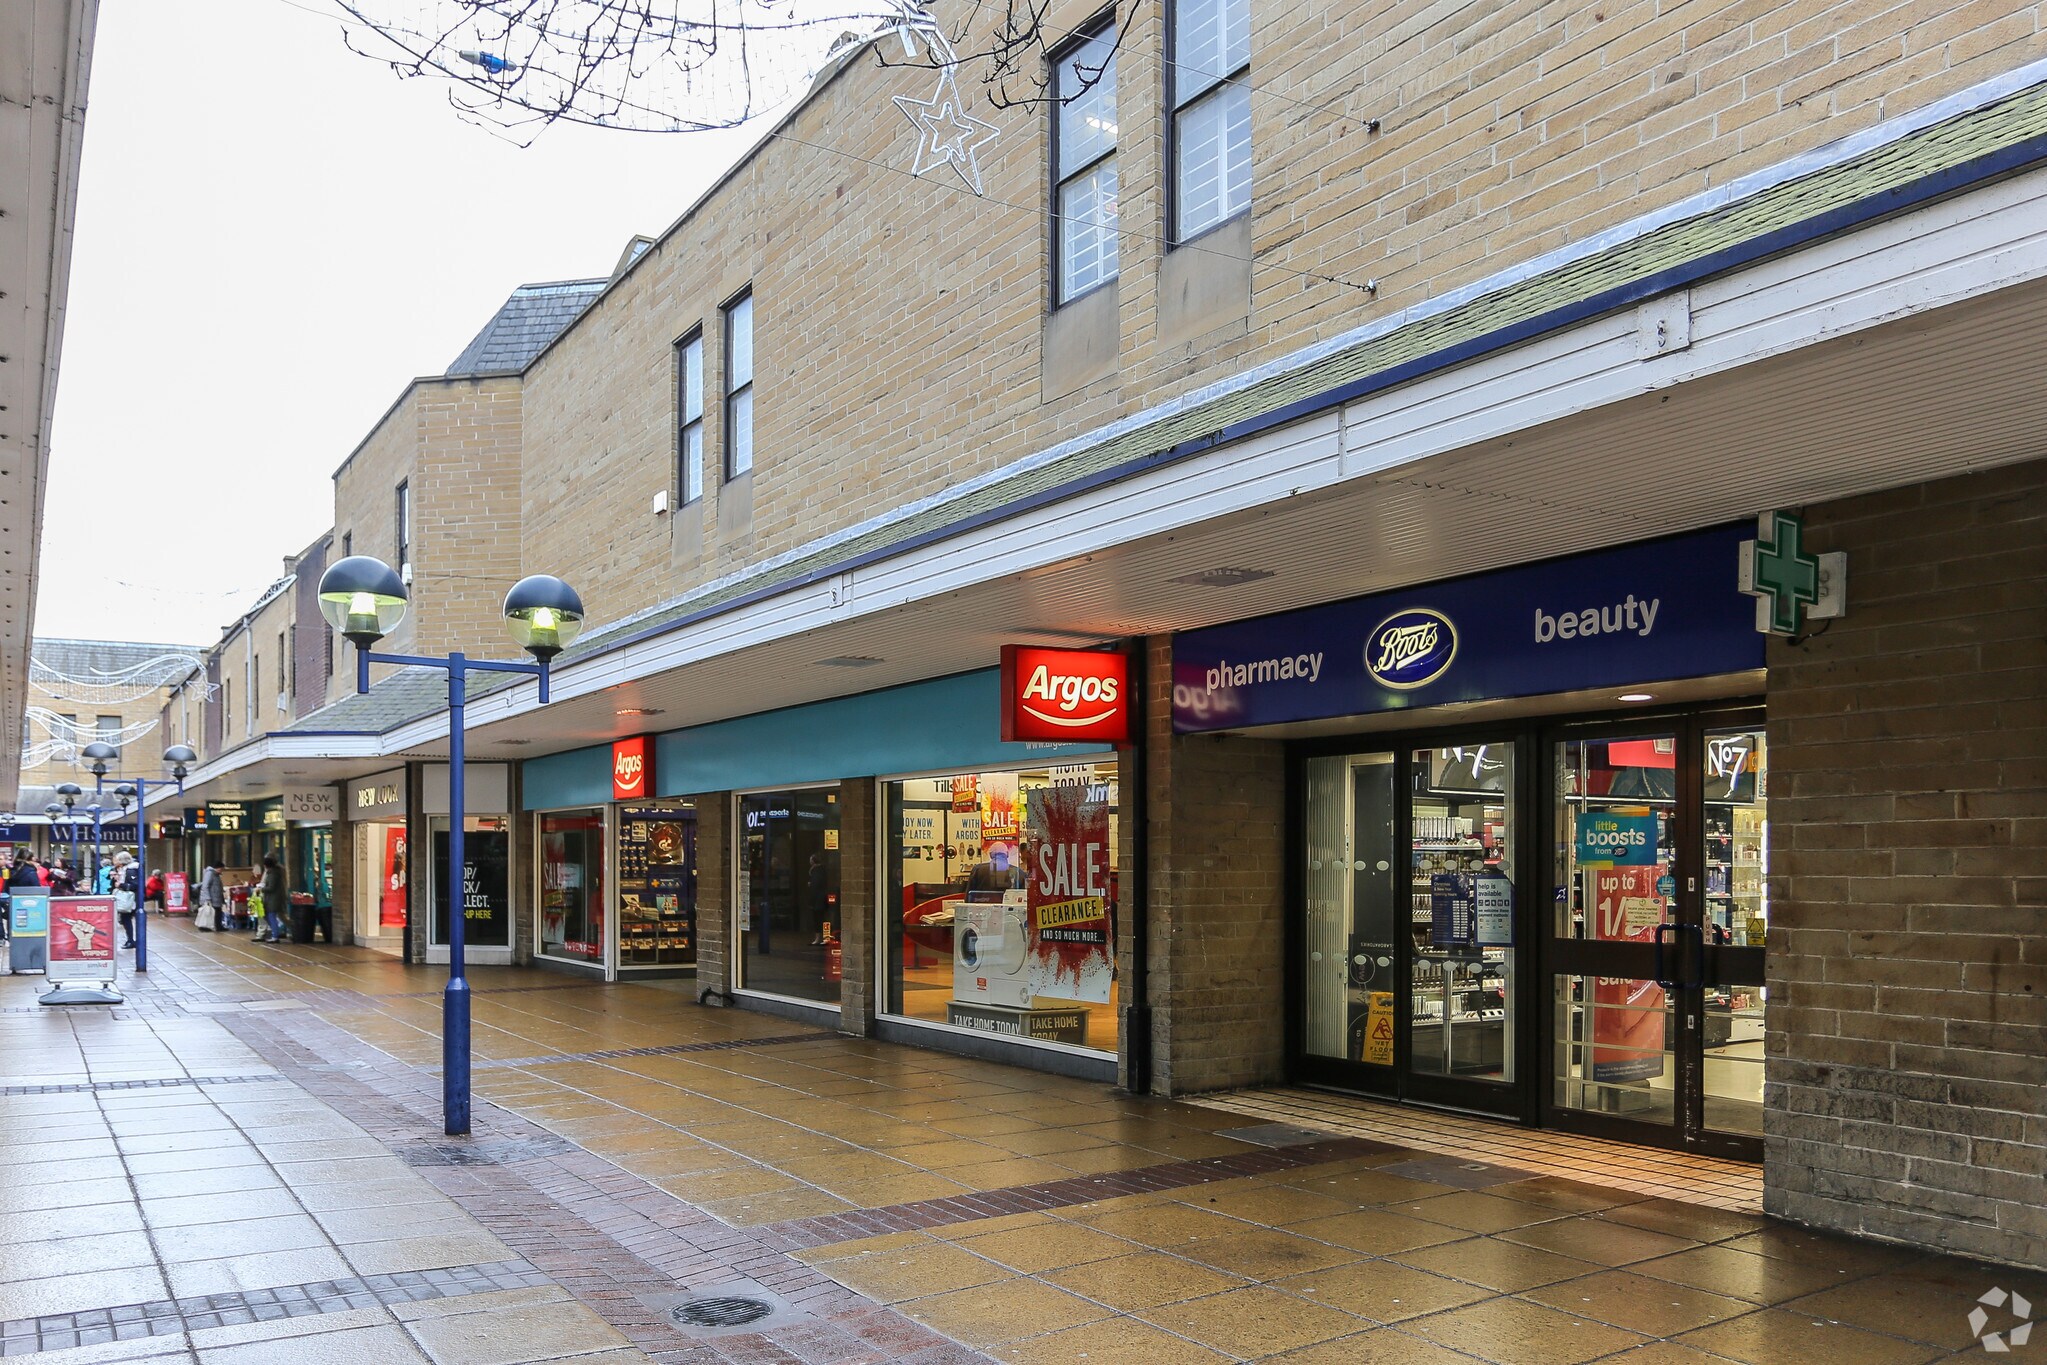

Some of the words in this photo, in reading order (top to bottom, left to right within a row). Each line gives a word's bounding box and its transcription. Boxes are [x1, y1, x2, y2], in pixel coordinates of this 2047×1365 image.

[1534, 594, 1660, 644] beauty
[1373, 621, 1439, 672] Boots
[1206, 652, 1323, 696] pharmacy
[1022, 665, 1118, 711] Argos
[615, 752, 643, 780] Argos
[1708, 738, 1748, 792] No7
[1054, 776, 1090, 788] TODAY
[293, 793, 330, 803] NEW
[358, 787, 376, 808] NEW
[377, 784, 399, 804] LOOK
[290, 803, 334, 813] LOOK
[219, 815, 240, 830] £1
[917, 817, 935, 828] NOW.
[961, 818, 980, 828] WITH
[1595, 820, 1617, 831] little
[910, 829, 934, 839] LATER.
[955, 830, 978, 840] ARGOS
[1586, 828, 1646, 846] boosts
[1594, 847, 1612, 855] from
[1039, 842, 1105, 897] SALE.
[1601, 876, 1619, 892] up
[1621, 874, 1636, 890] to
[475, 909, 492, 919] HERE
[1042, 929, 1053, 940] AND
[1054, 930, 1063, 940] SO
[1063, 931, 1080, 941] MUCH
[954, 1014, 973, 1027] TAKE
[973, 1017, 995, 1031] HOME
[996, 1021, 1020, 1036] TODAY
[1032, 1017, 1053, 1030] TAKE
[1054, 1016, 1078, 1029] HOME
